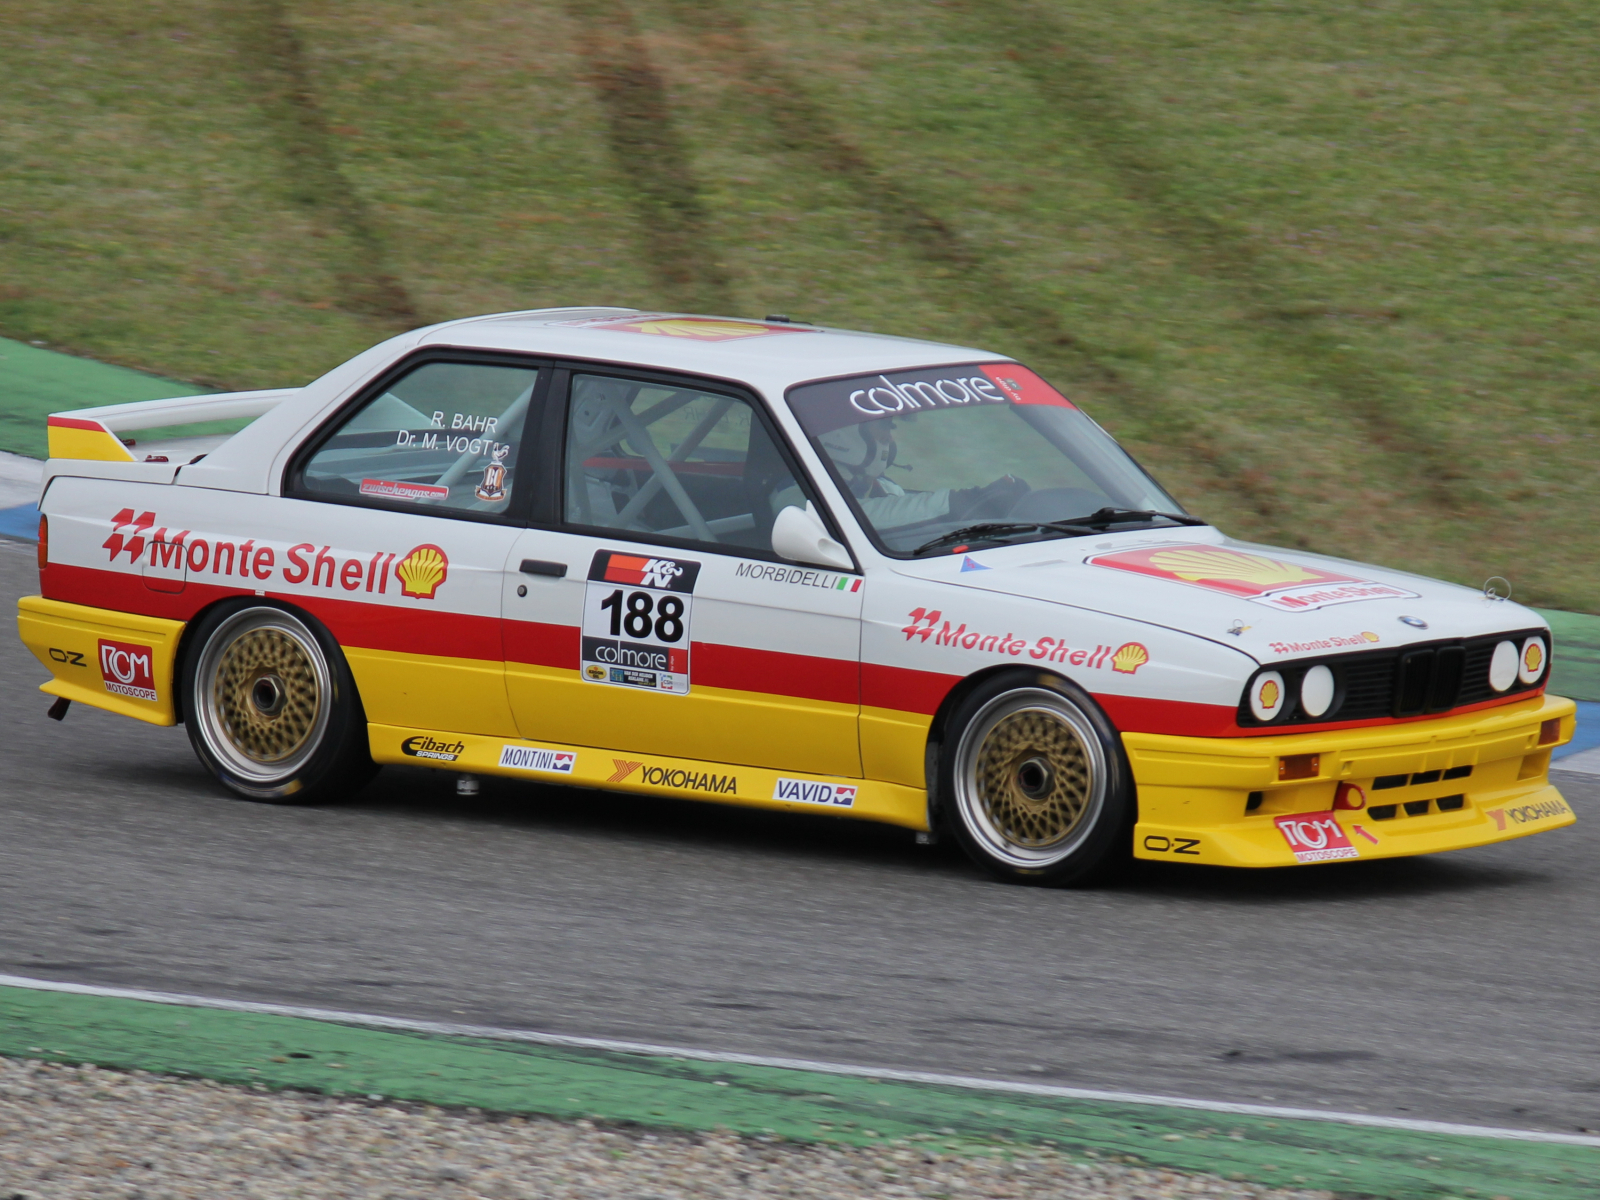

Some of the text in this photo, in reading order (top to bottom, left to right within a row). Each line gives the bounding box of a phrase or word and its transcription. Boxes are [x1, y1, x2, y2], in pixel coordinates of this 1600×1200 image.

[850, 375, 1004, 414] colmore
[430, 411, 498, 433] R. BAHR
[396, 430, 493, 456] Dr. M. VOGT
[362, 482, 446, 499] zwischengas.com
[150, 527, 396, 594] Monte Shell
[735, 562, 838, 589] MORBIDELLI
[1271, 588, 1346, 608] Monte
[601, 589, 684, 642] 188
[595, 640, 667, 670] colmore
[935, 621, 1111, 669] Monte Shell
[1287, 634, 1366, 653] Monte Shell
[105, 682, 156, 701] MOTOSCOPE
[401, 736, 465, 755] Eibach
[415, 750, 454, 761] SPRINGS
[501, 747, 554, 769] MONTINI
[641, 765, 737, 795] YOKOHAMA
[778, 780, 832, 803] VAVID
[1504, 800, 1571, 824] YOKOHAMA
[1296, 848, 1358, 862] MOTOSCOPE
